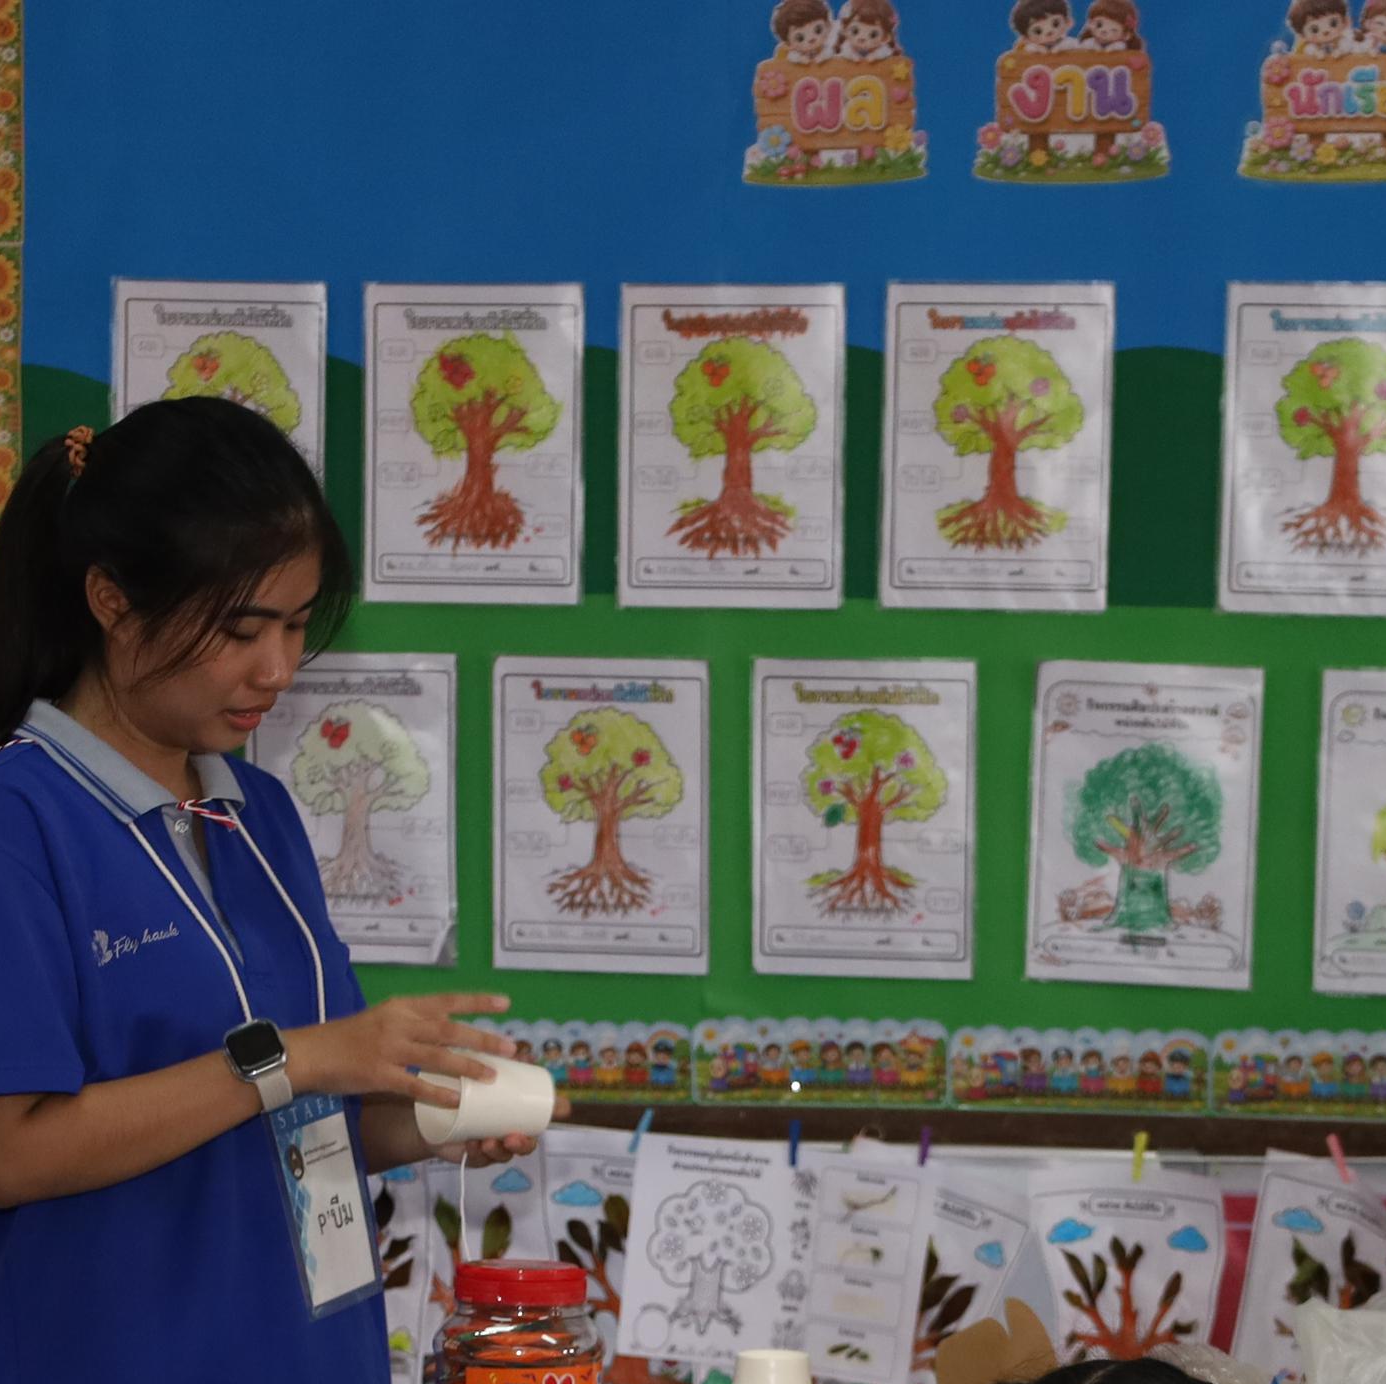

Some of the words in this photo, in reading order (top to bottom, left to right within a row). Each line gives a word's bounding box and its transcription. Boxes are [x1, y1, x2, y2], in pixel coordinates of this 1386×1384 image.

[791, 77, 886, 132] ผล
[1009, 65, 1136, 121] งาน
[277, 1093, 337, 1129] STAFF
